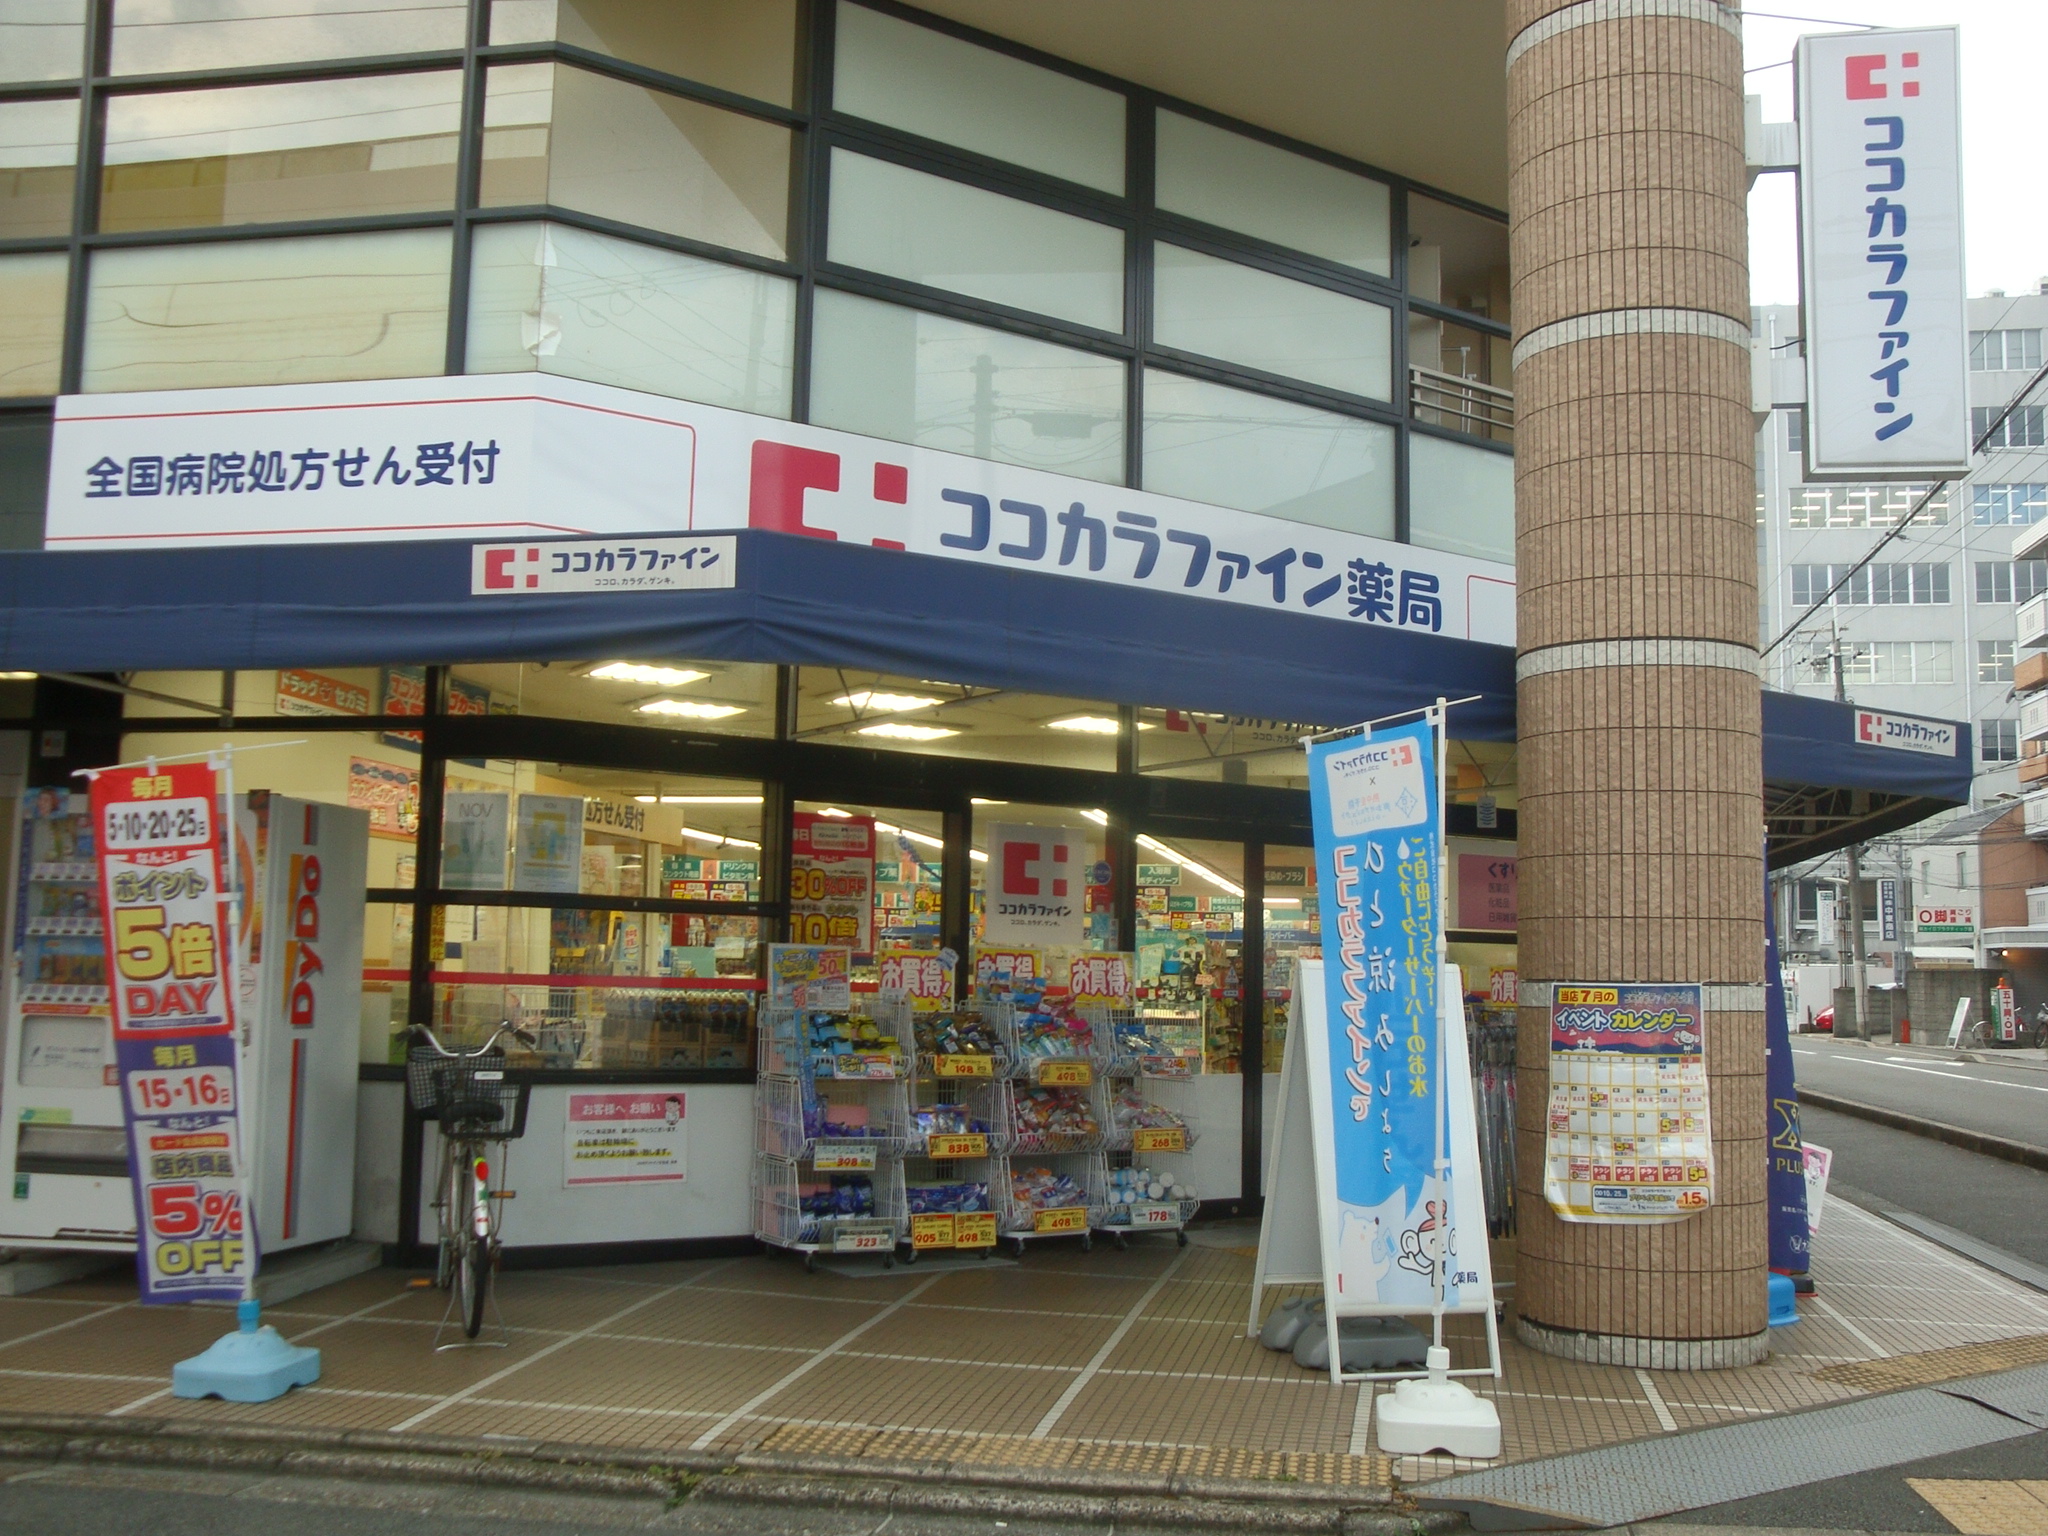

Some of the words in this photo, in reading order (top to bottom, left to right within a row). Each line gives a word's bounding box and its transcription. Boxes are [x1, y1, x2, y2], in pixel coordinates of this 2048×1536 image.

[1863, 115, 1914, 442] ココカラファイン
[84, 438, 501, 499] 全国病院処方せん受付
[551, 546, 720, 573] ココカラファイン
[939, 486, 1442, 634] ココカラファイン薬局
[1886, 721, 1951, 744] ココカラファイン
[131, 775, 173, 798] 毎月
[458, 802, 495, 819] NOV
[113, 867, 209, 903] ポイント
[998, 903, 1072, 917] ココカラファイン
[113, 904, 217, 982] 5倍
[1490, 971, 1518, 1004] お買
[1560, 989, 1616, 1003] 当店7月の
[124, 980, 217, 1019] DAY
[1555, 1007, 1694, 1033] イベントカレンダー
[152, 1044, 197, 1068] 毎月
[948, 1143, 970, 1154] 838
[1151, 1138, 1170, 1148] 268
[147, 1181, 243, 1240] 5%
[1148, 1210, 1168, 1222] 178
[1051, 1217, 1071, 1229] 498
[855, 1237, 877, 1248] 323
[915, 1233, 936, 1243] 905
[957, 1232, 979, 1244] 498
[154, 1238, 244, 1277] OFF
